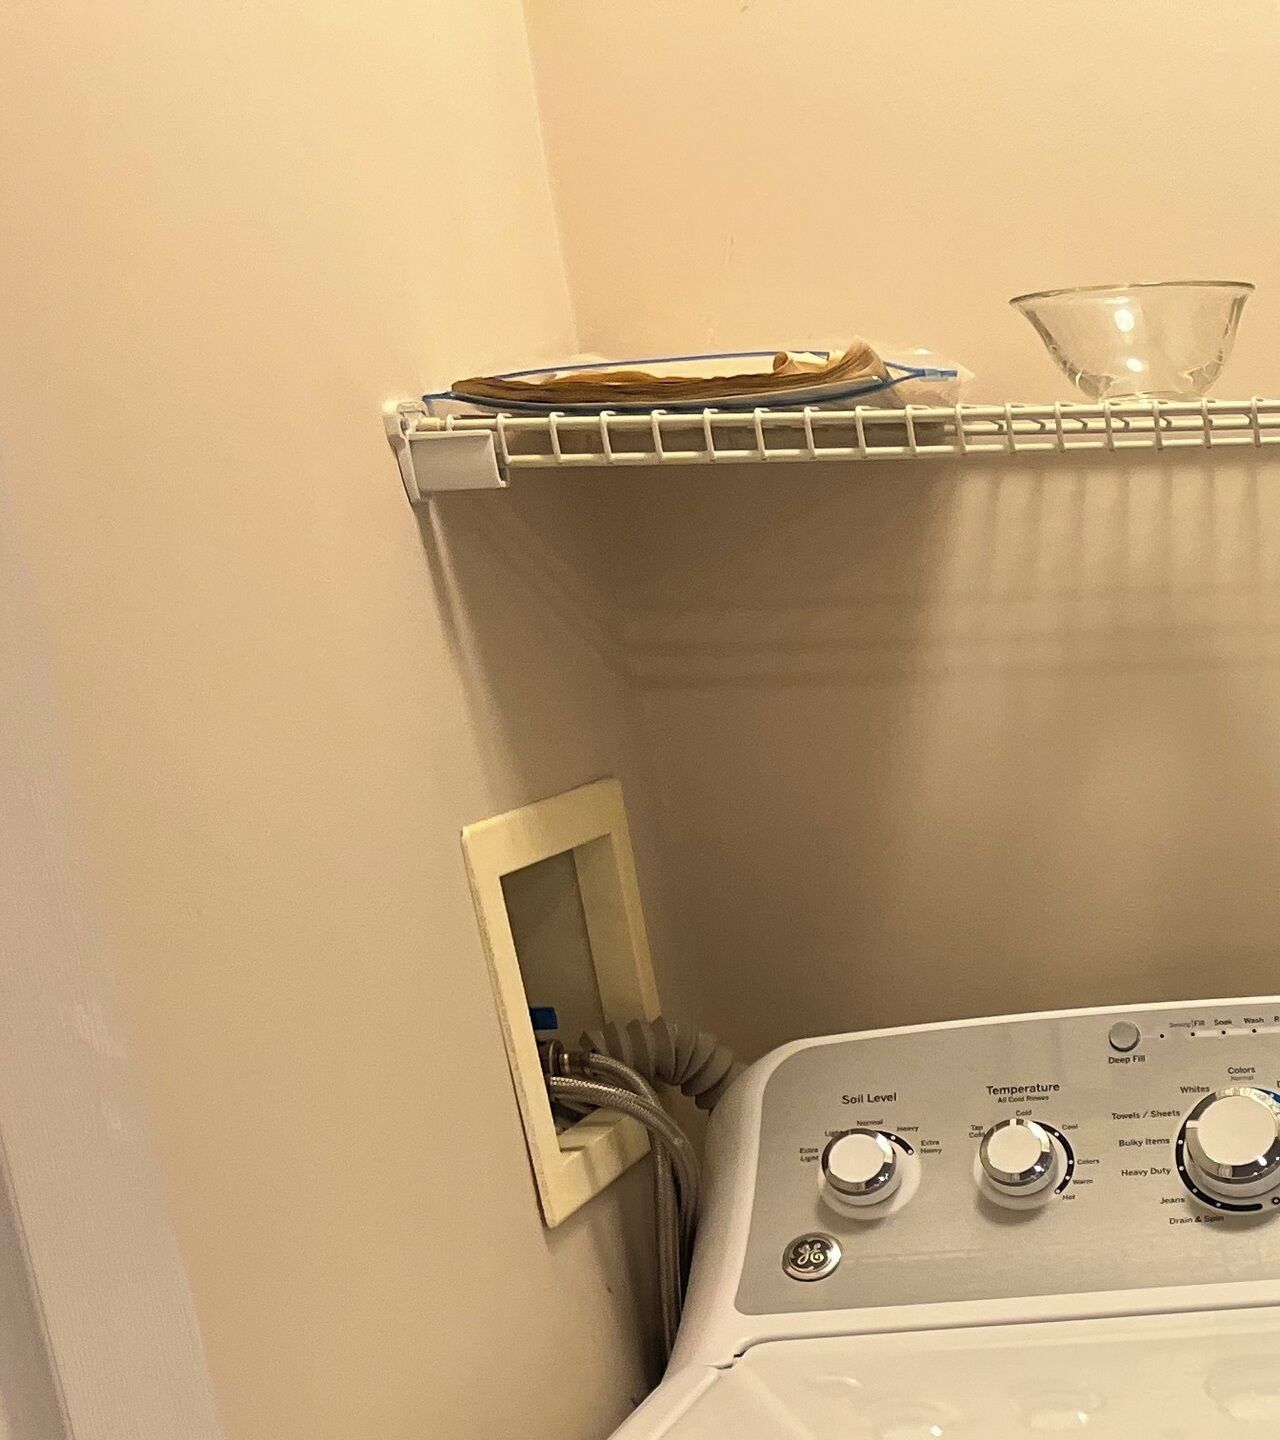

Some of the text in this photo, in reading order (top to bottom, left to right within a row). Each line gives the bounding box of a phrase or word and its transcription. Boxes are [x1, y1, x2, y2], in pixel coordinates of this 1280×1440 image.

[1214, 1018, 1233, 1026] Soak
[1244, 1016, 1265, 1024] Wash
[1108, 1055, 1146, 1065] Deep Fill
[1228, 1066, 1256, 1075] Colors
[986, 1082, 1061, 1096] Temperature
[1180, 1085, 1211, 1094] Whites
[842, 1092, 897, 1105] Soil Level
[1112, 1110, 1141, 1120] Towels
[1150, 1109, 1181, 1119] Sheets
[1119, 1137, 1171, 1148] Bulky Items
[1121, 1166, 1171, 1178] Heavy Duty
[1160, 1196, 1186, 1205] Jeans
[1169, 1214, 1225, 1225] Drain & Spin
